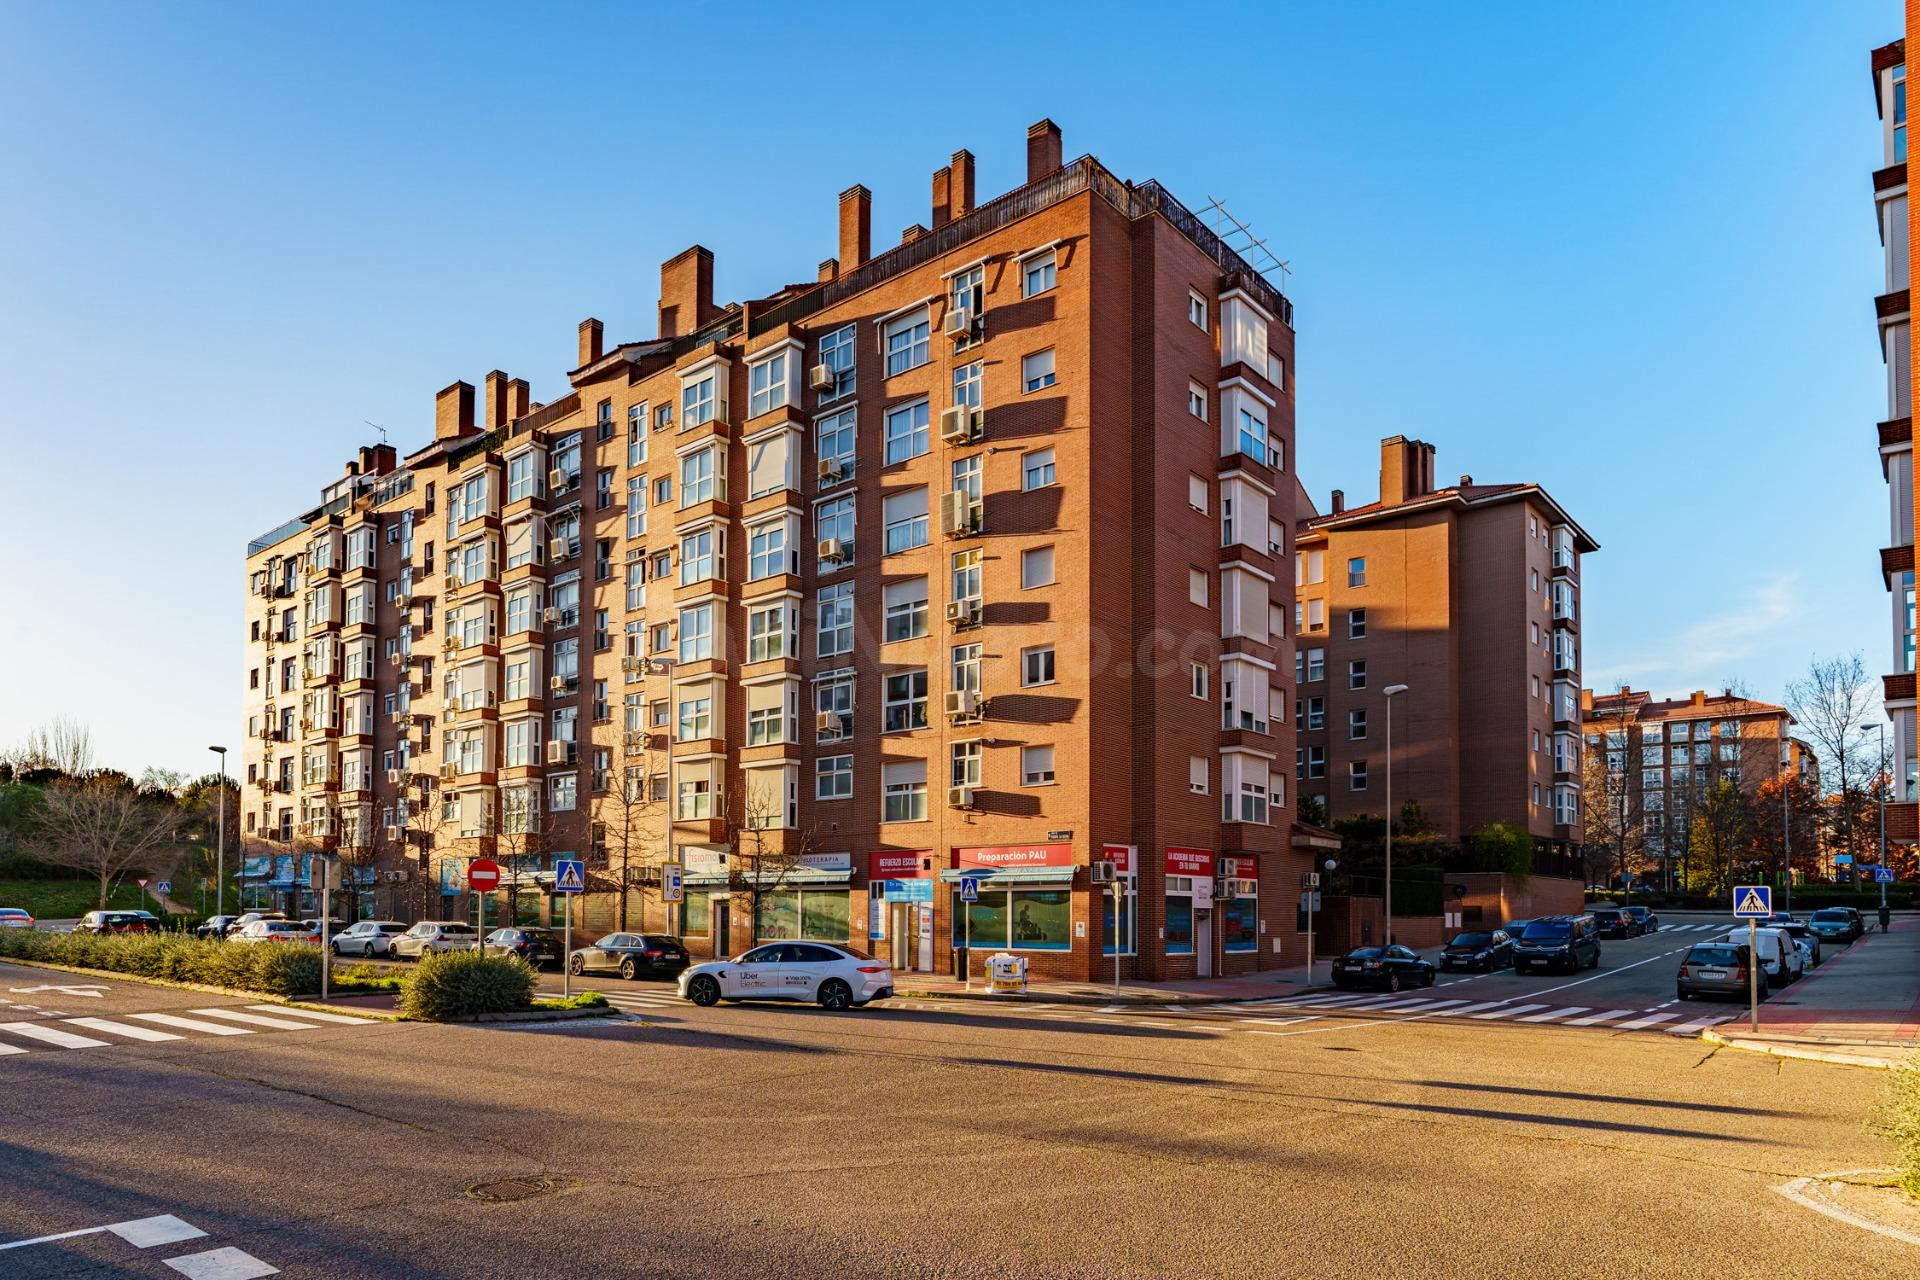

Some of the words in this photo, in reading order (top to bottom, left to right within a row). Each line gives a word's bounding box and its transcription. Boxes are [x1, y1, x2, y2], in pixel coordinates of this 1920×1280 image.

[977, 851, 1027, 863] Preparación
[1029, 850, 1047, 860] PAU
[740, 972, 758, 980] Uber
